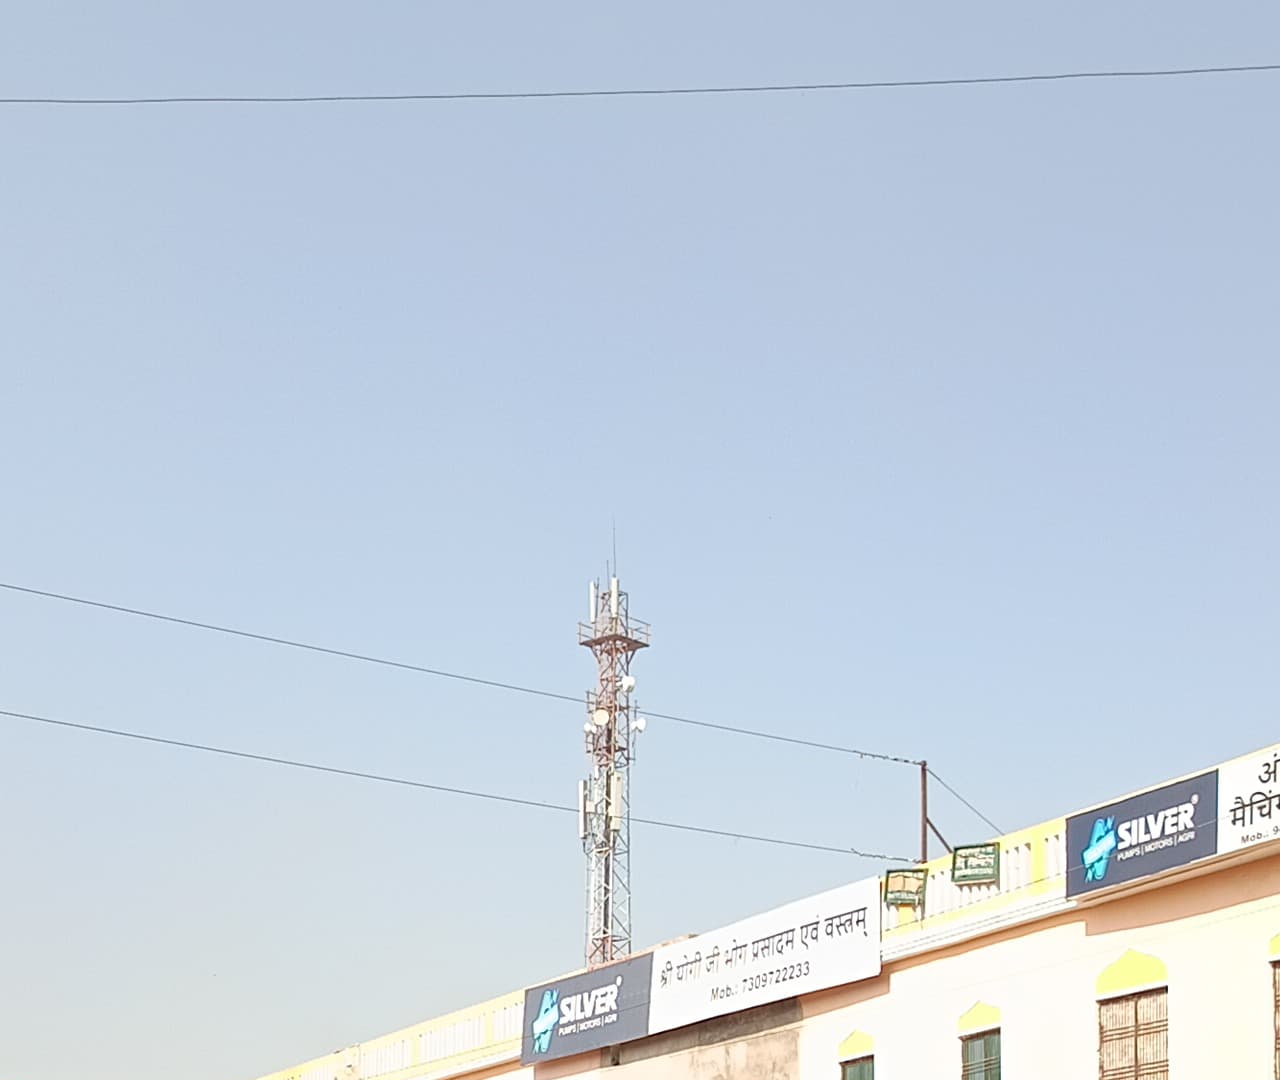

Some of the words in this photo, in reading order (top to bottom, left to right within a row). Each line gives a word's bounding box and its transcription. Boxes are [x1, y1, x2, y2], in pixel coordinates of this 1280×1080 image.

[1117, 802, 1195, 850] SILVER
[705, 945, 720, 973] जी
[800, 914, 820, 950] एवं
[742, 961, 810, 994] 7309722233
[559, 984, 618, 1024] SILVER
